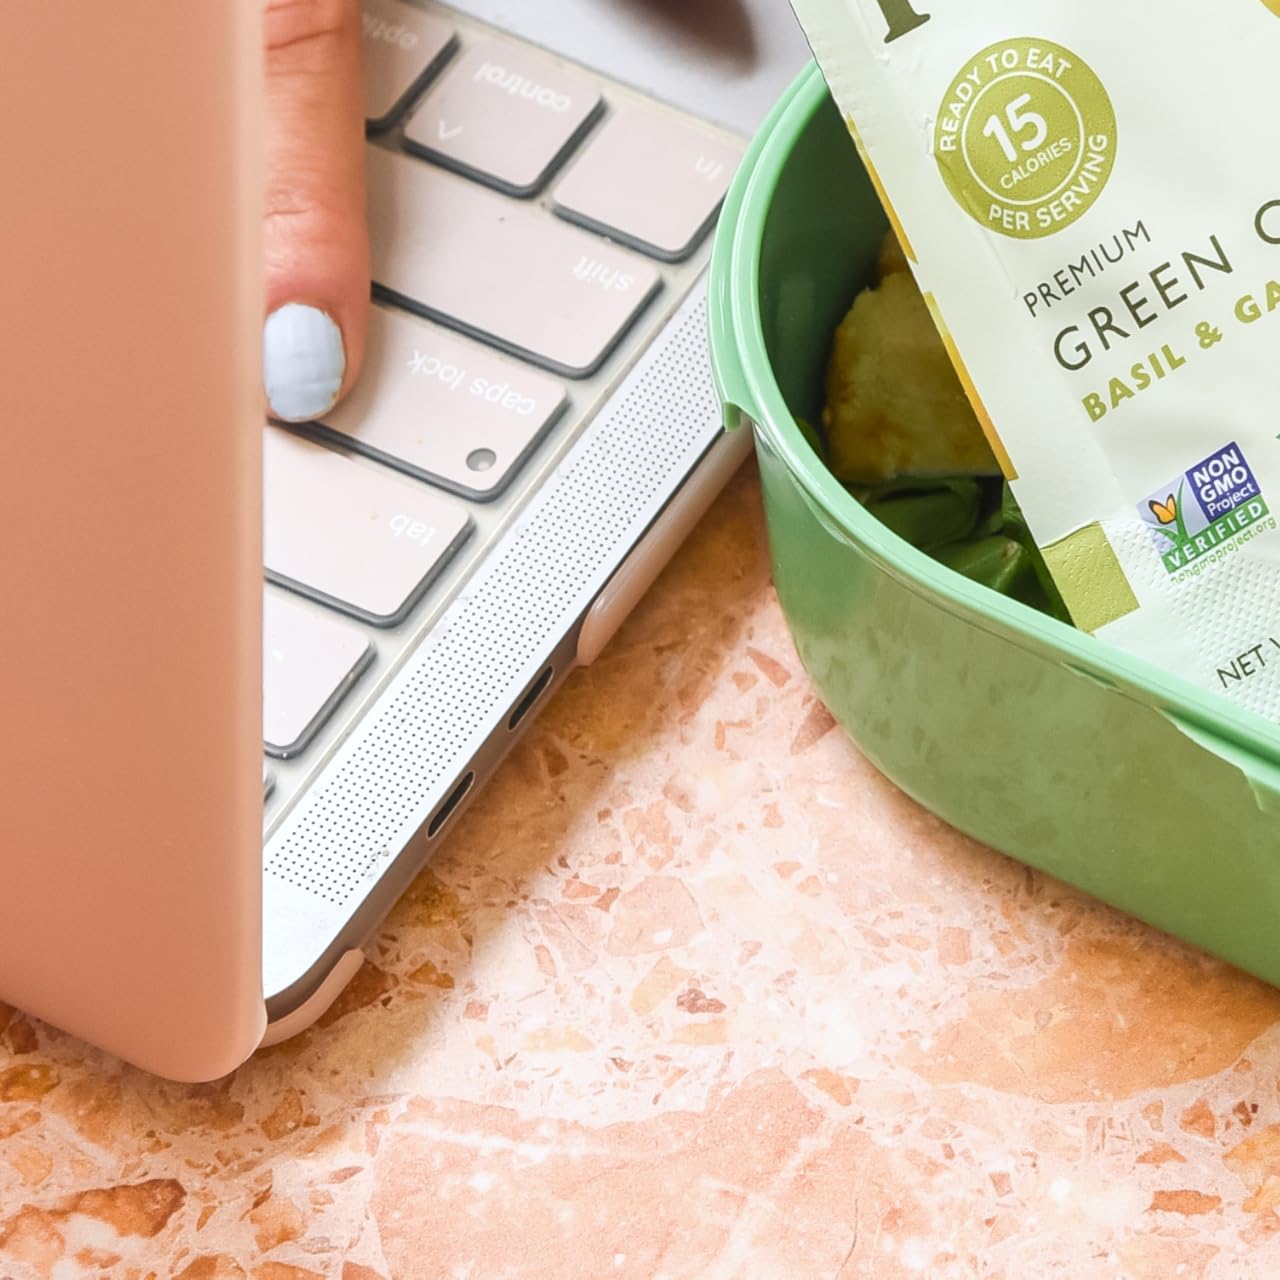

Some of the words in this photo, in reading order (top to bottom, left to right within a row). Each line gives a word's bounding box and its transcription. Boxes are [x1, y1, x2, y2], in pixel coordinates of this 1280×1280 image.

[362, 14, 418, 49] opti
[474, 60, 572, 113] control
[940, 66, 982, 151] READY
[985, 48, 1019, 73] TO
[1026, 48, 1072, 78] EAT
[983, 93, 1048, 162] 15
[988, 204, 1030, 231] PER
[1036, 134, 1107, 228] SERVING
[1000, 137, 1072, 189] CALORIES
[573, 255, 634, 290] shift
[1022, 219, 1152, 317] PREMIUM
[1053, 234, 1233, 371] GREEN
[408, 349, 465, 390] lock
[469, 376, 536, 415] caps
[1081, 343, 1186, 423] BASIL
[1195, 321, 1223, 349] &
[1193, 449, 1240, 487] NON
[1200, 466, 1248, 503] GMO
[1207, 483, 1255, 517] Project
[389, 513, 435, 546] tab
[1168, 502, 1262, 567] VERIFIED
[1171, 517, 1277, 585] nongmoproject.org
[1216, 644, 1265, 689] NET
